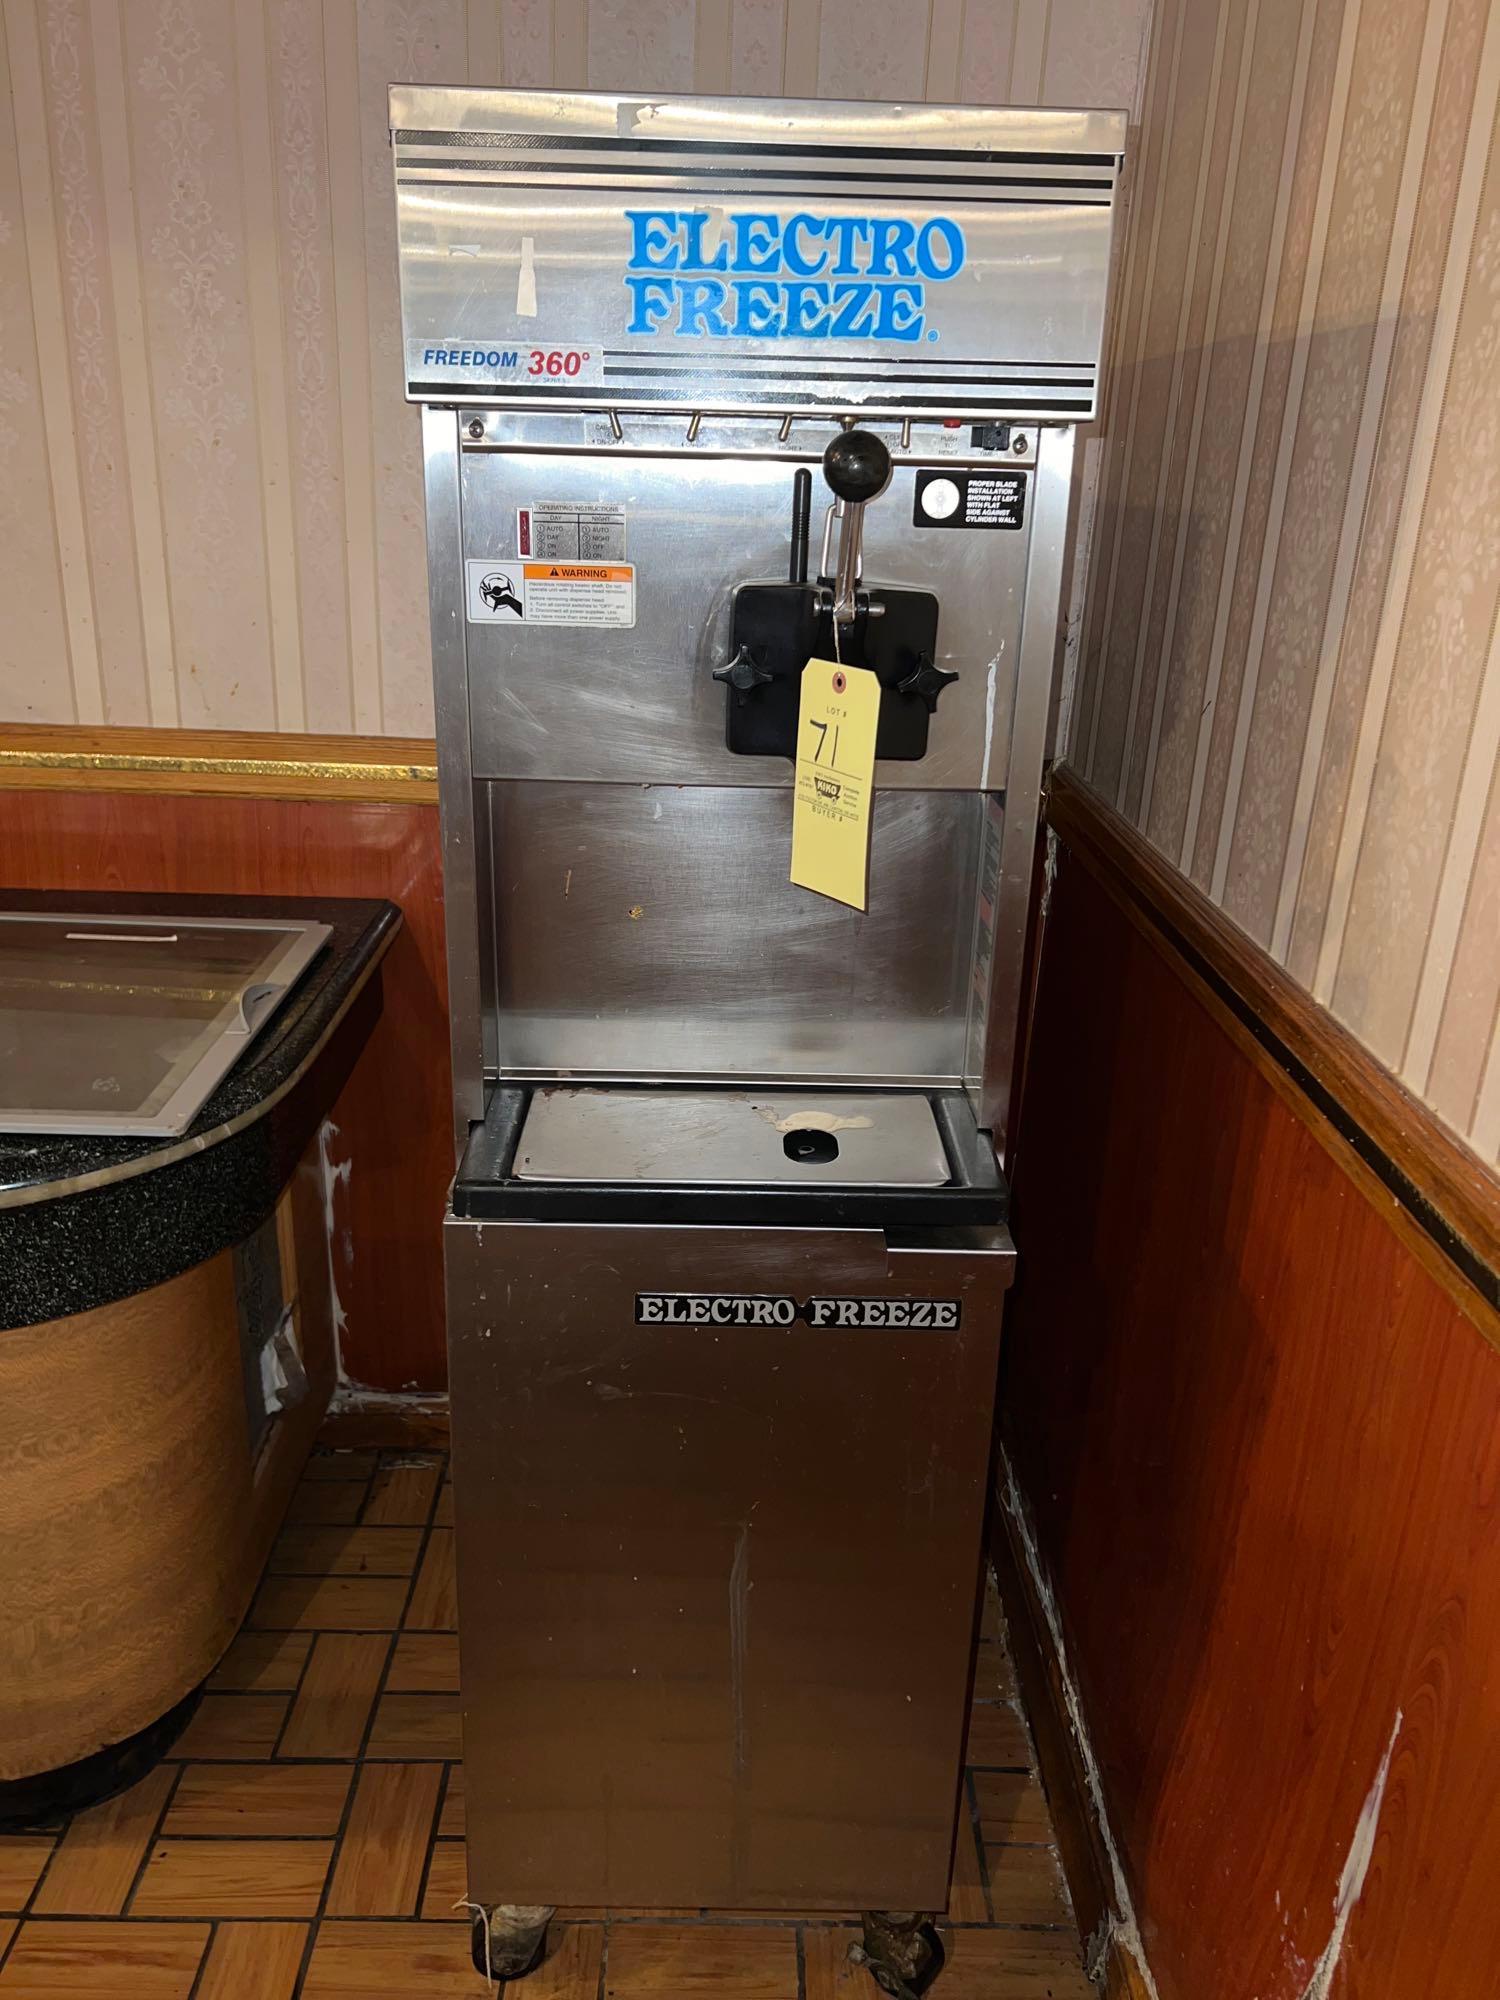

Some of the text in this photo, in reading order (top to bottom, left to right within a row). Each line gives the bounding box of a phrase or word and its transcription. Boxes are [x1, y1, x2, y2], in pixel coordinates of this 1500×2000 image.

[624, 210, 966, 281] ELECTRO
[424, 350, 517, 367] FREEDOM
[561, 568, 607, 578] WARNING
[826, 706, 841, 717] LOT
[809, 719, 839, 768] 71
[817, 780, 838, 796] KIKO
[812, 805, 837, 821] BUYER
[639, 1298, 957, 1327] ELECTRO FREEZE
